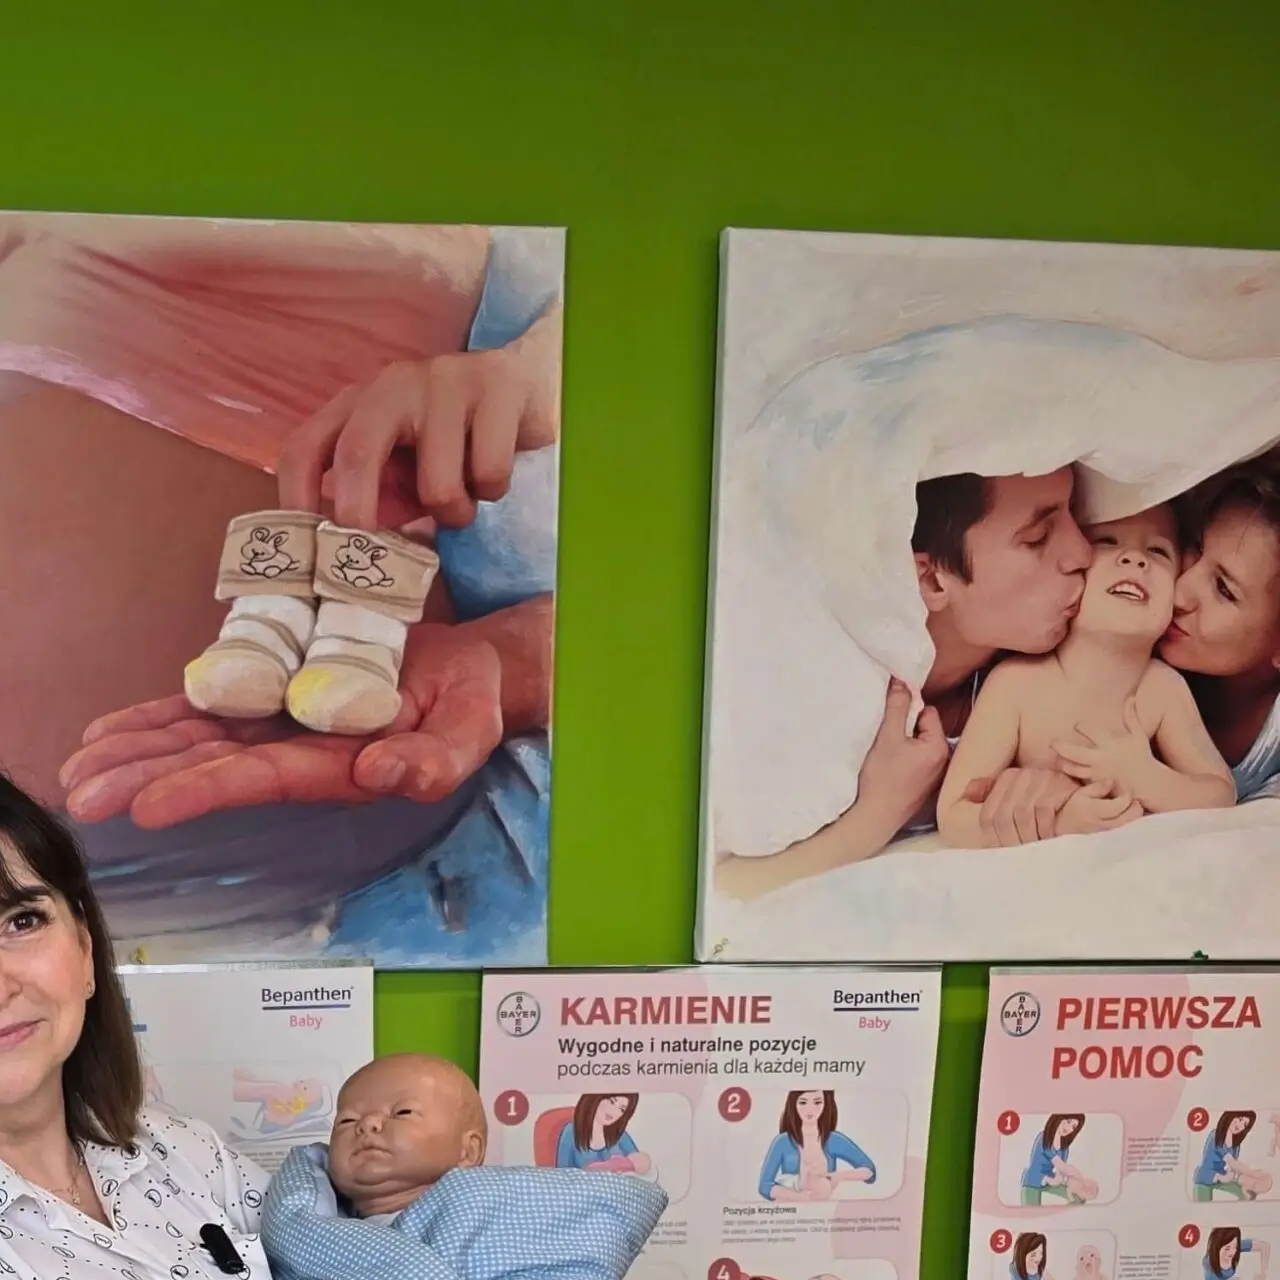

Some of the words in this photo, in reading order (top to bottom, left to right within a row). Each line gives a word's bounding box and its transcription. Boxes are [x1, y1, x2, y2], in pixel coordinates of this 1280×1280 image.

[261, 987, 352, 1005] Bepanthen
[833, 989, 921, 1006] Bepanthen
[500, 1011, 537, 1019] BAYER
[560, 996, 772, 1026] KARMIENIE
[1004, 1010, 1037, 1018] BAYER
[1056, 996, 1262, 1031] PIERWSZA
[289, 1015, 323, 1029] Baby
[858, 1016, 891, 1031] Baby
[558, 1037, 644, 1057] Wygodne
[650, 1037, 655, 1052] i
[661, 1037, 744, 1052] naturalne
[749, 1036, 817, 1055] pozycje
[557, 1060, 631, 1080] podczas
[636, 1059, 719, 1075] karmienia
[723, 1058, 749, 1074] dla
[754, 1057, 808, 1077] każdej
[813, 1060, 866, 1076] mamy
[1051, 1044, 1204, 1080] POMOC
[507, 1097, 517, 1117] 1
[726, 1095, 741, 1114] 2
[1004, 1115, 1013, 1130] 1
[1193, 1113, 1202, 1127] 2
[723, 1206, 756, 1216] Pozycja
[996, 1234, 1007, 1248] 3
[1185, 1230, 1194, 1243] 4
